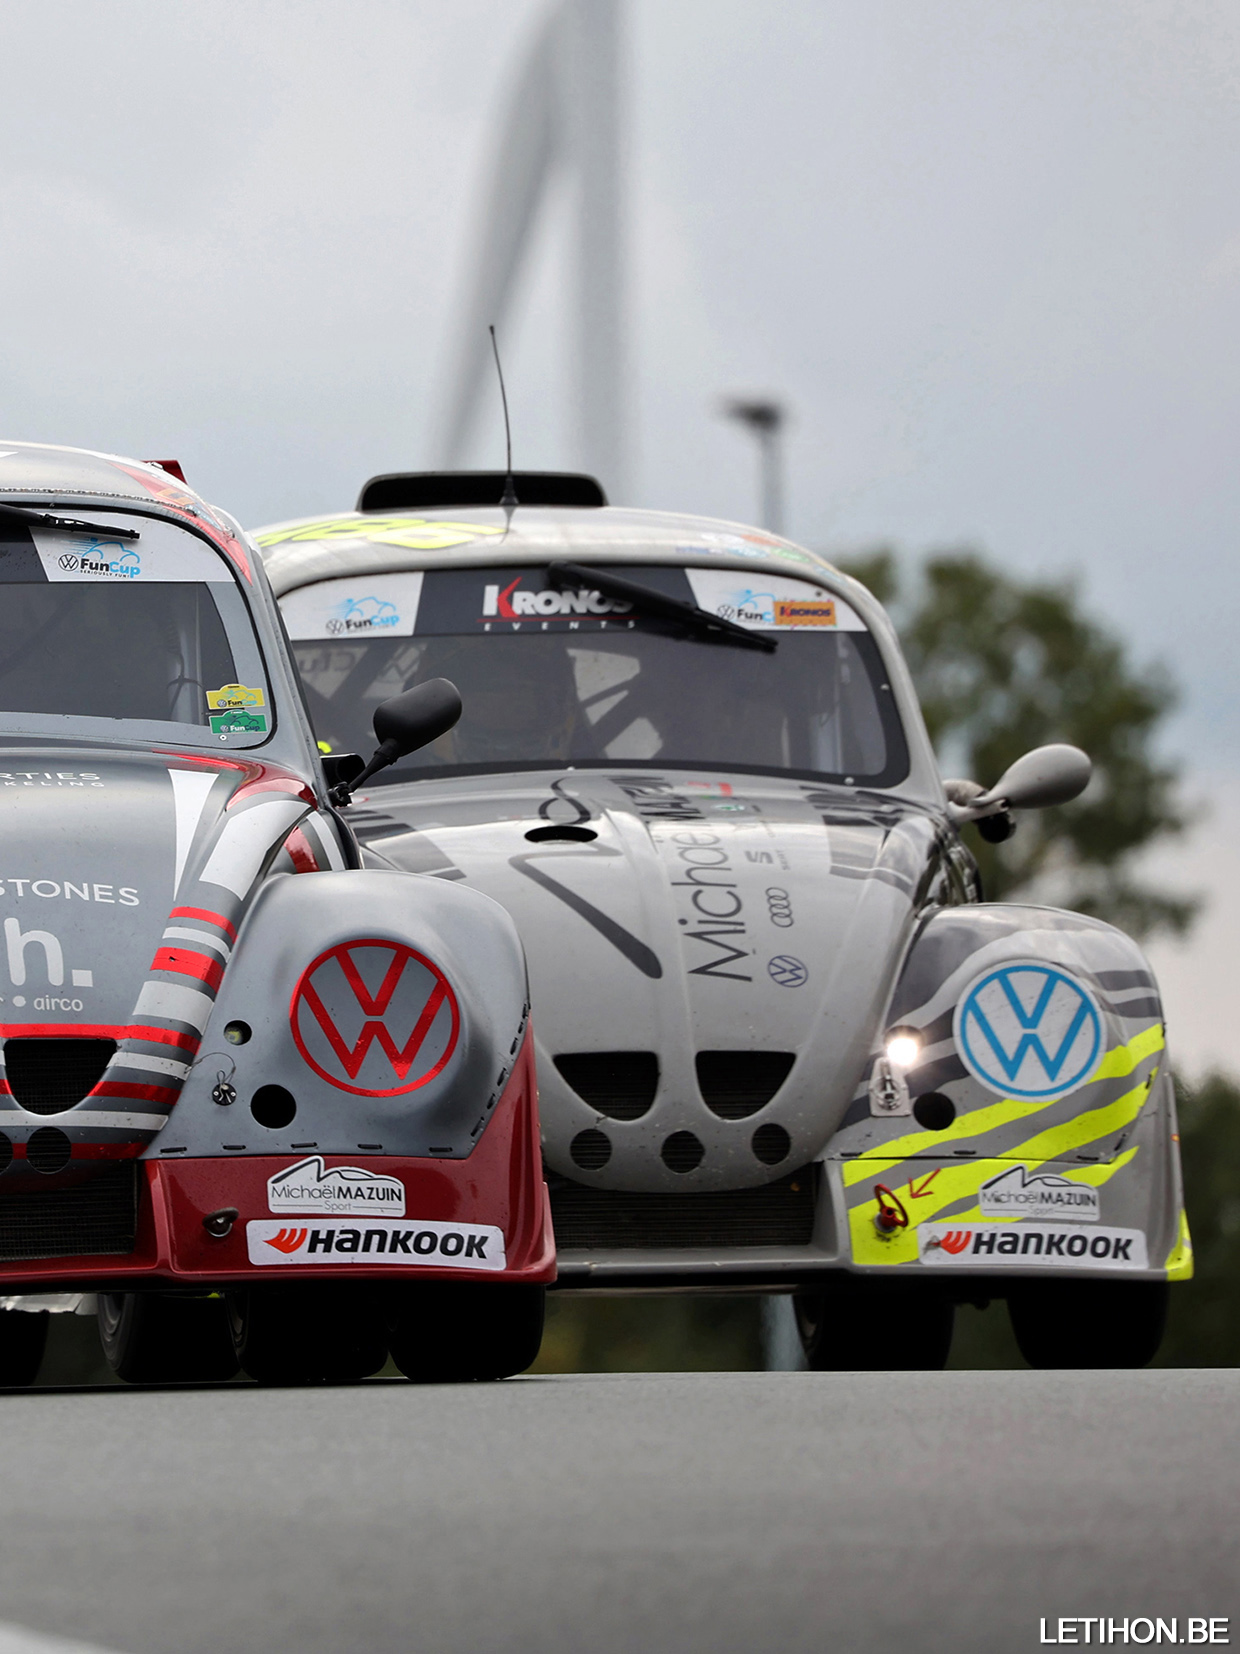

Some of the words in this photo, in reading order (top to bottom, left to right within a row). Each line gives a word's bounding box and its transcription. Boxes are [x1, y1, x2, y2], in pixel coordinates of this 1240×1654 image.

[81, 558, 141, 578] FunCup
[345, 615, 400, 629] FunCup
[737, 609, 774, 622] FunC
[484, 620, 635, 631] EVENTS
[33, 995, 84, 1012] airco
[324, 1201, 352, 1212] Sport
